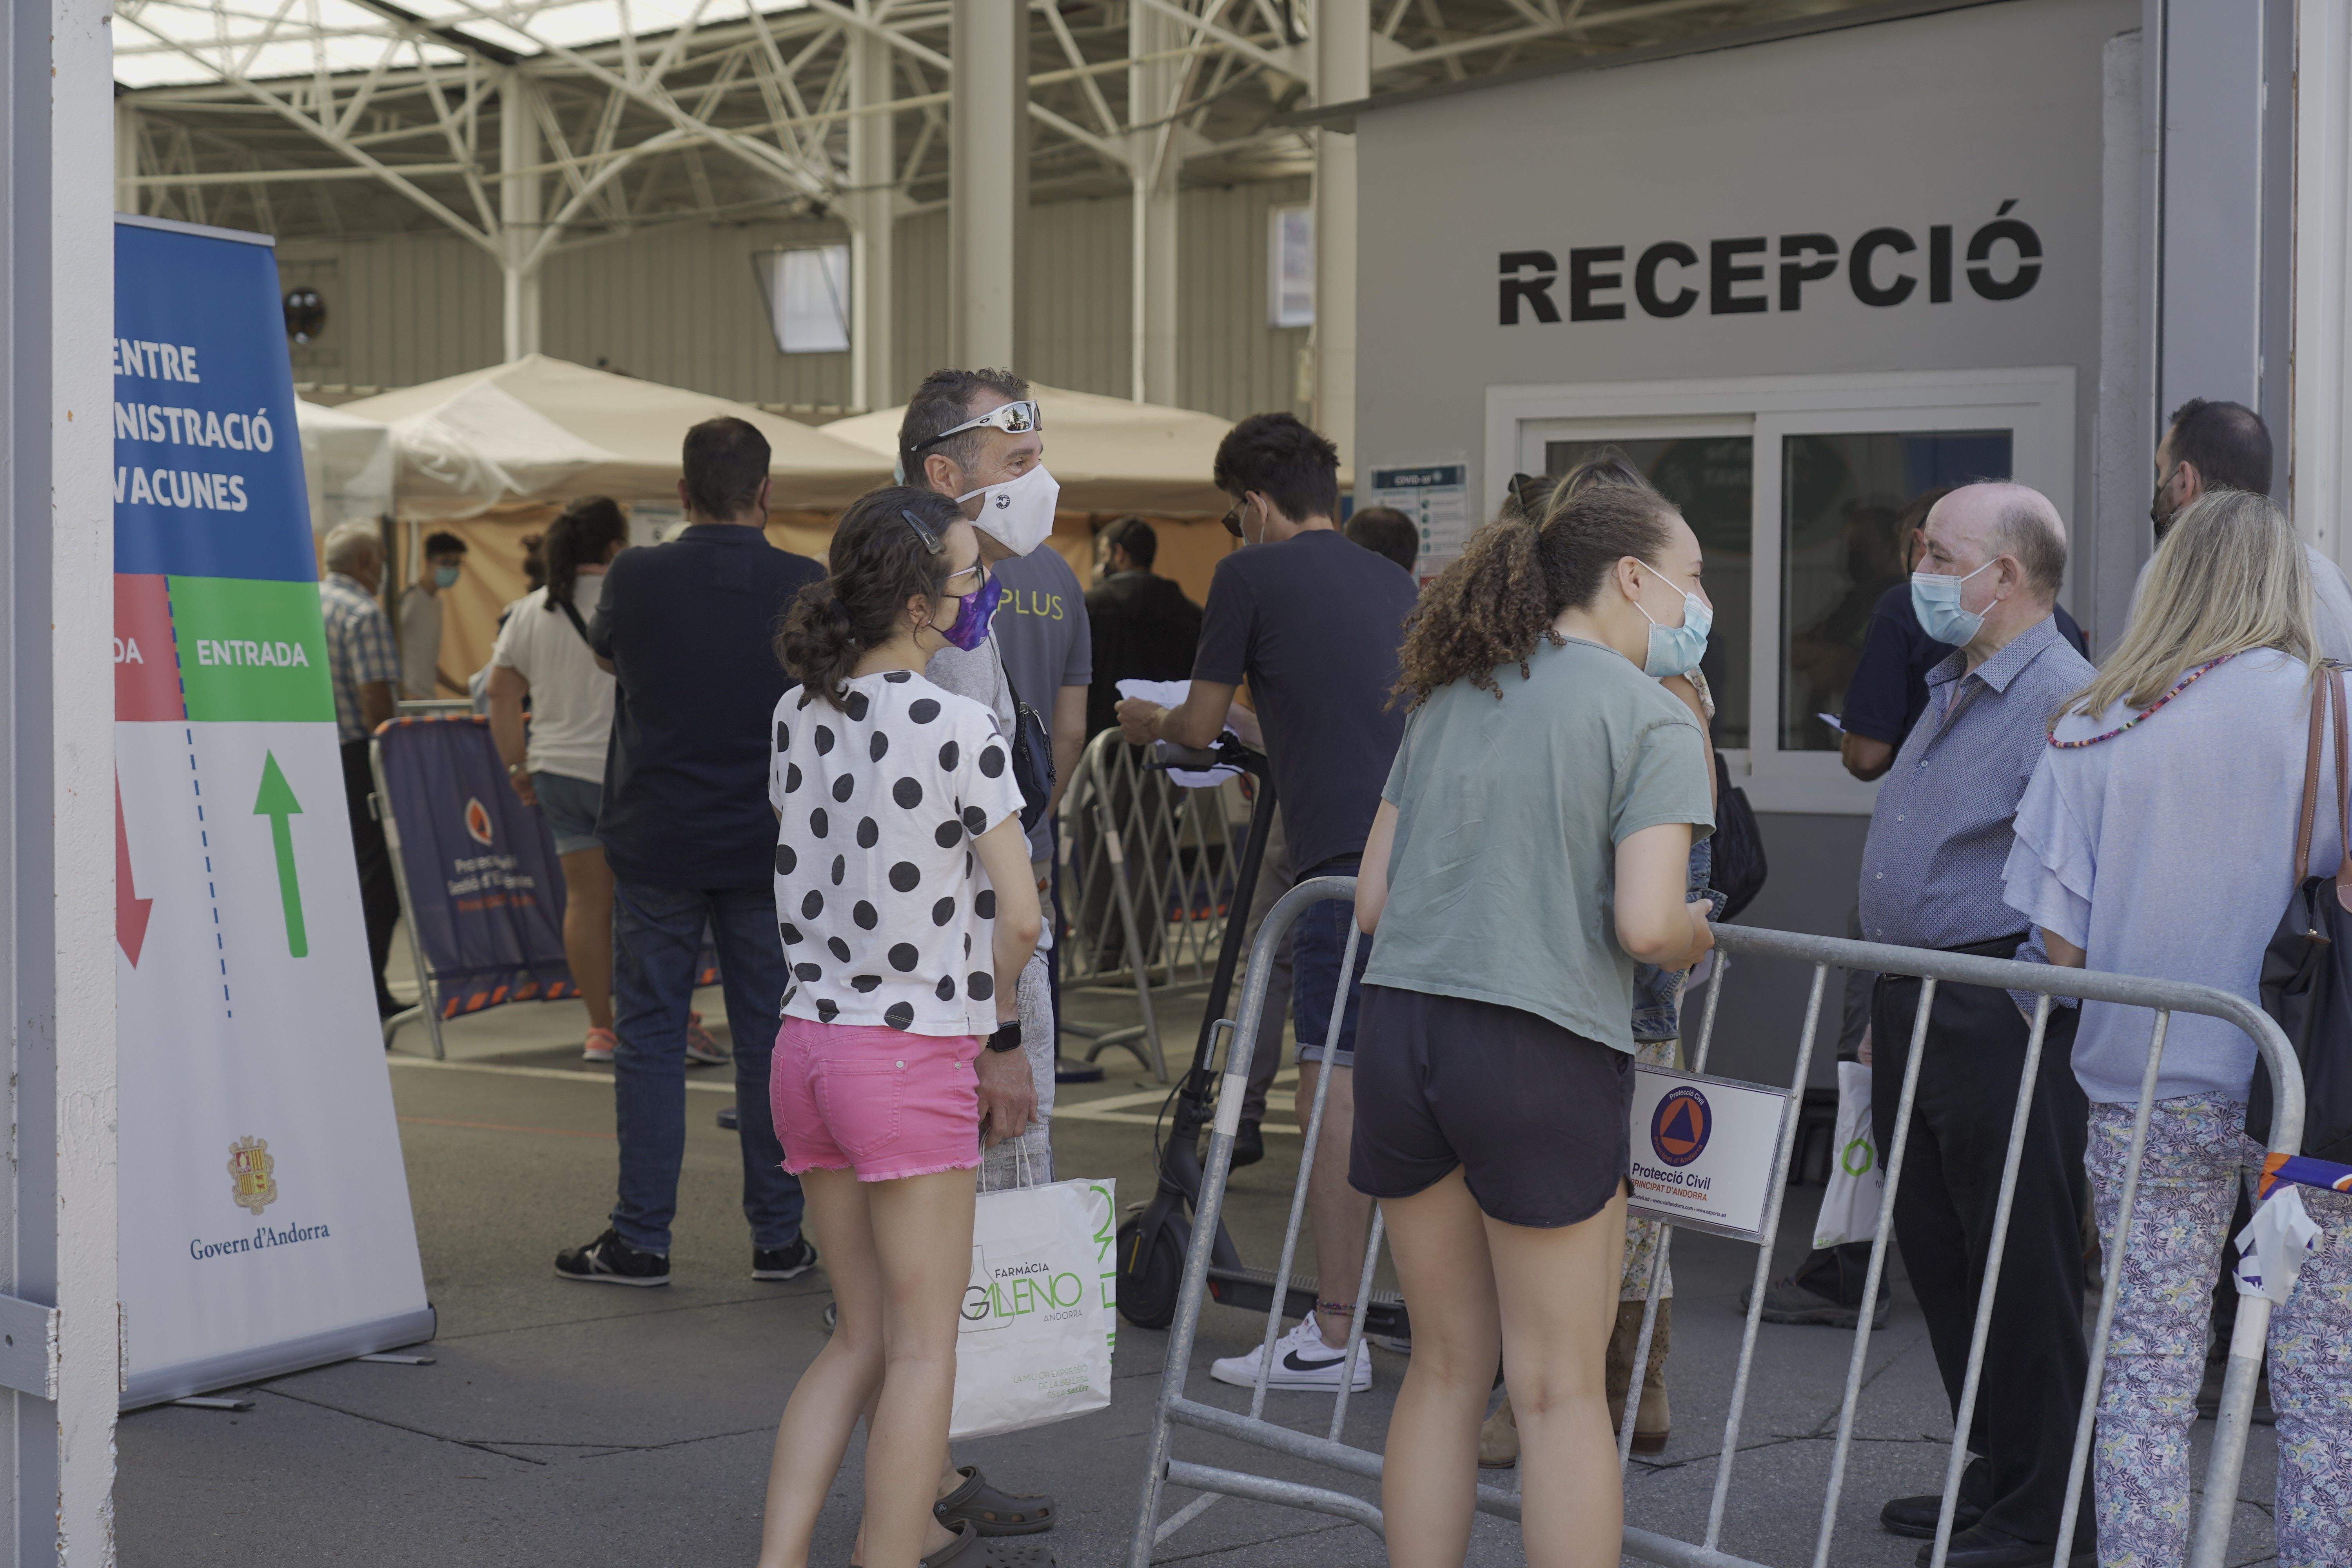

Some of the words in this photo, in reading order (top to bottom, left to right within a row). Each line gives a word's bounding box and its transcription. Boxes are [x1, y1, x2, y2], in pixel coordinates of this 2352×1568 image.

[1499, 200, 2043, 325] RECEPCIÓ
[114, 466, 248, 512] VACUNES
[997, 588, 1063, 620] PLUS
[197, 639, 309, 667] ENTRADA
[1670, 1090, 1694, 1100] Protecció
[1694, 1093, 1705, 1105] Civil
[1653, 1136, 1672, 1163] Principat
[1632, 1163, 1683, 1184] Protecció
[1686, 1174, 1711, 1190] Civil
[1666, 1186, 1708, 1201] D'ANDORRA
[1652, 1199, 1693, 1210] www.visitandorra.com
[1696, 1207, 1726, 1218] www.esports.ad
[190, 1238, 250, 1260] Govern
[254, 1221, 330, 1250] d'Andorra
[995, 1262, 1049, 1278] FARMÀCIA
[961, 1272, 1082, 1320] GALENO
[1044, 1310, 1082, 1323] ANDORRA
[1024, 1371, 1049, 1381] MILLOR
[1051, 1363, 1088, 1377] EXPRESSIÓ
[1060, 1376, 1088, 1386] BELLESA
[1047, 1390, 1055, 1399] ÉS
[1067, 1386, 1089, 1395] SALUT
